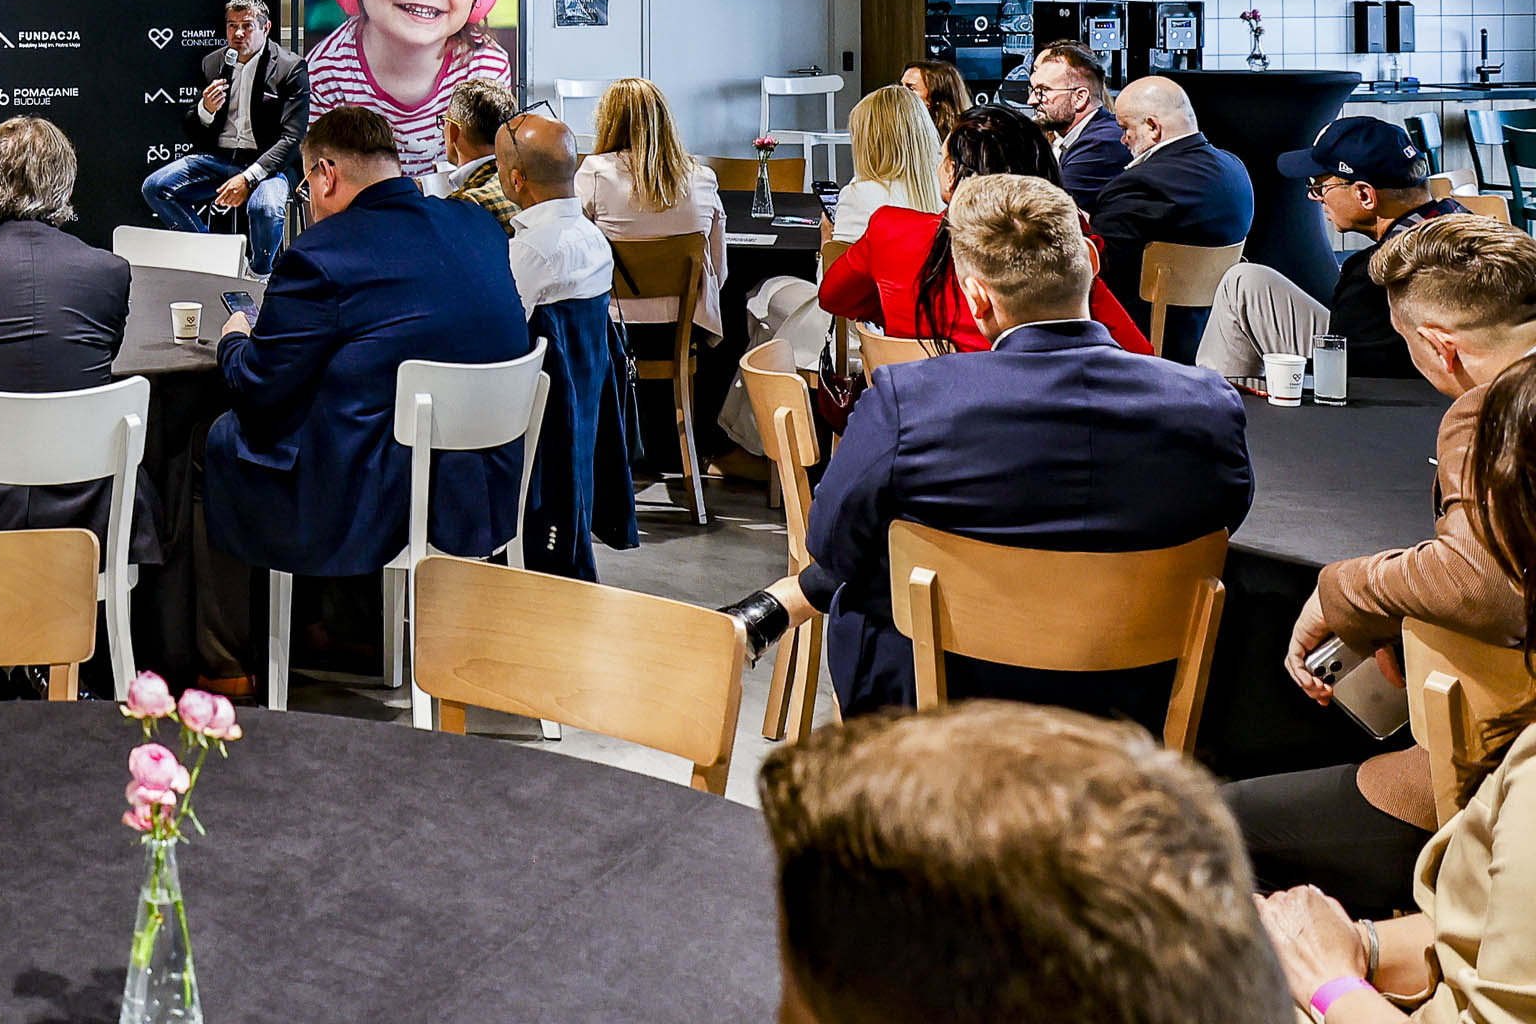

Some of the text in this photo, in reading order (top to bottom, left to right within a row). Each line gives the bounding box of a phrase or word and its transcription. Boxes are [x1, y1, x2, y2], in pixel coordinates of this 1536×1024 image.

[18, 31, 81, 41] FUNDACJA
[181, 30, 216, 38] CHARITY
[14, 88, 79, 97] POMAGANIE
[14, 97, 51, 106] BUDUJE
